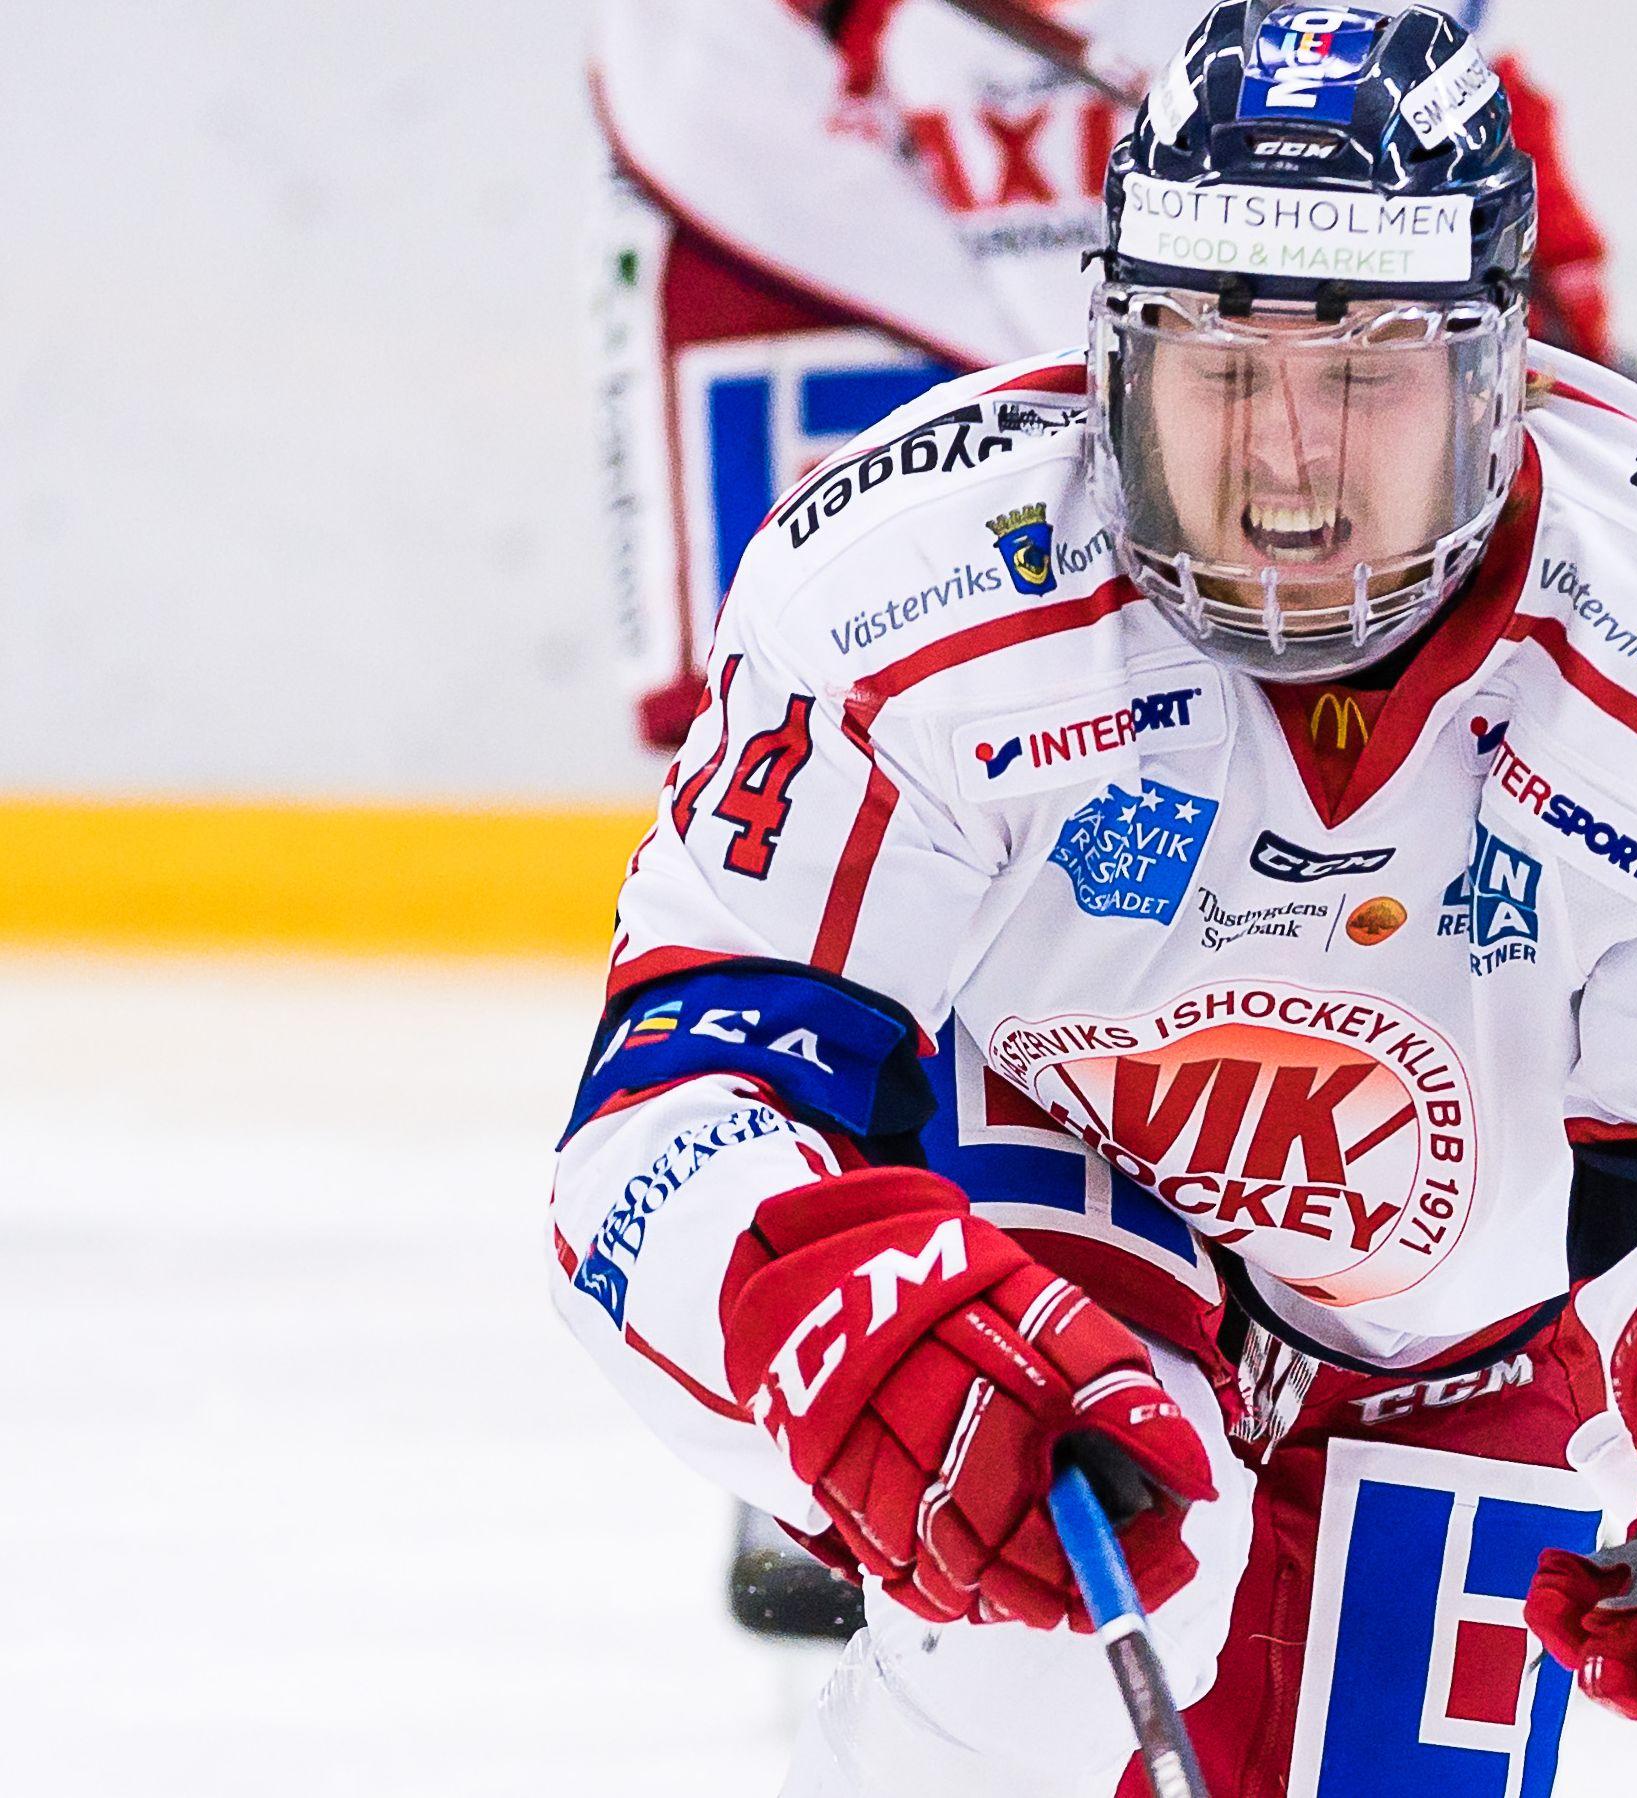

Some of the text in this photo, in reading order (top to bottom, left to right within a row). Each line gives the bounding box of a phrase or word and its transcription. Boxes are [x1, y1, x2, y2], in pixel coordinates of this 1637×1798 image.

[1254, 141, 1337, 159] CCM
[1130, 180, 1458, 238] SLOTTSHOLMEN
[1157, 231, 1414, 276] FOOD & MARKET
[830, 564, 1001, 655] Västerviks
[1029, 688, 1195, 768] INTERORT
[1070, 828, 1157, 884] RESRT
[1257, 843, 1388, 877] CCM
[1111, 1055, 1382, 1186] VIK
[1050, 1100, 1403, 1254] HOCKEY
[1398, 1178, 1460, 1256] 1971
[1349, 1352, 1536, 1426] CCM
